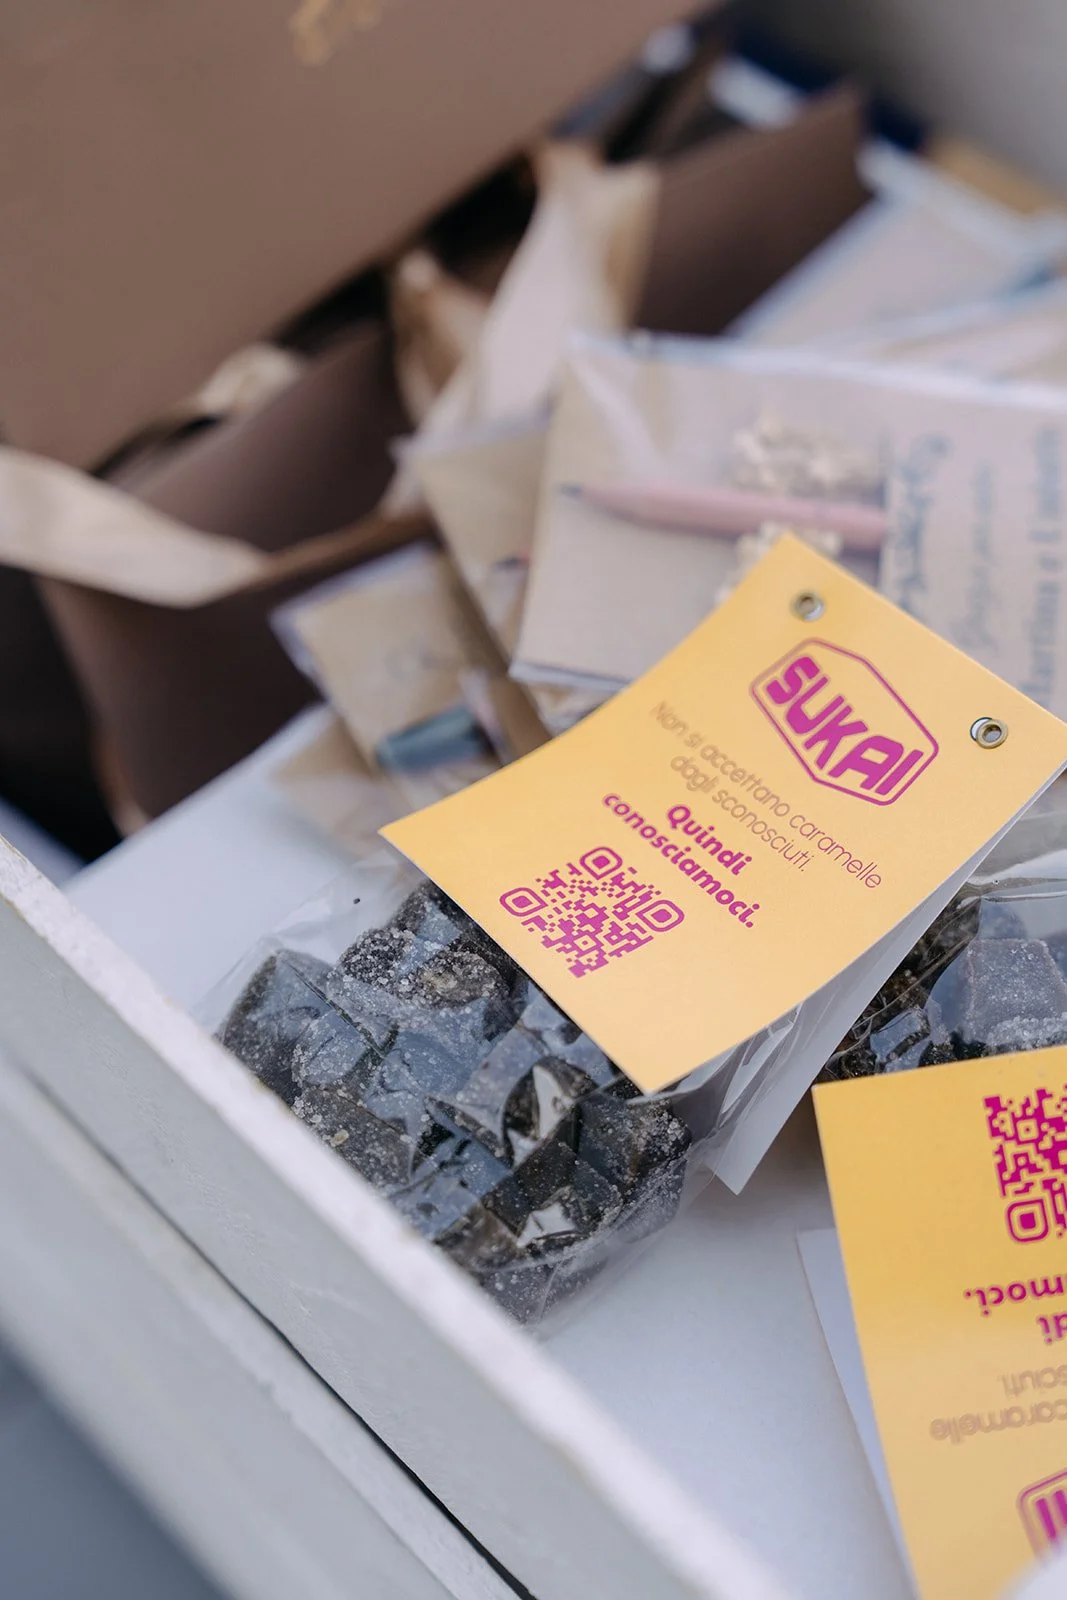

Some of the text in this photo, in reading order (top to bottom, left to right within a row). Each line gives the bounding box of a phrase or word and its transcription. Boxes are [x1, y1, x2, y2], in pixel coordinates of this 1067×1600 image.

[766, 656, 924, 796] SUKAI
[650, 701, 882, 888] Non si accettano caramelle
[667, 805, 752, 876] Quindi
[670, 755, 815, 872] dagli sconosciuti.
[603, 795, 760, 928] conosciamoci.
